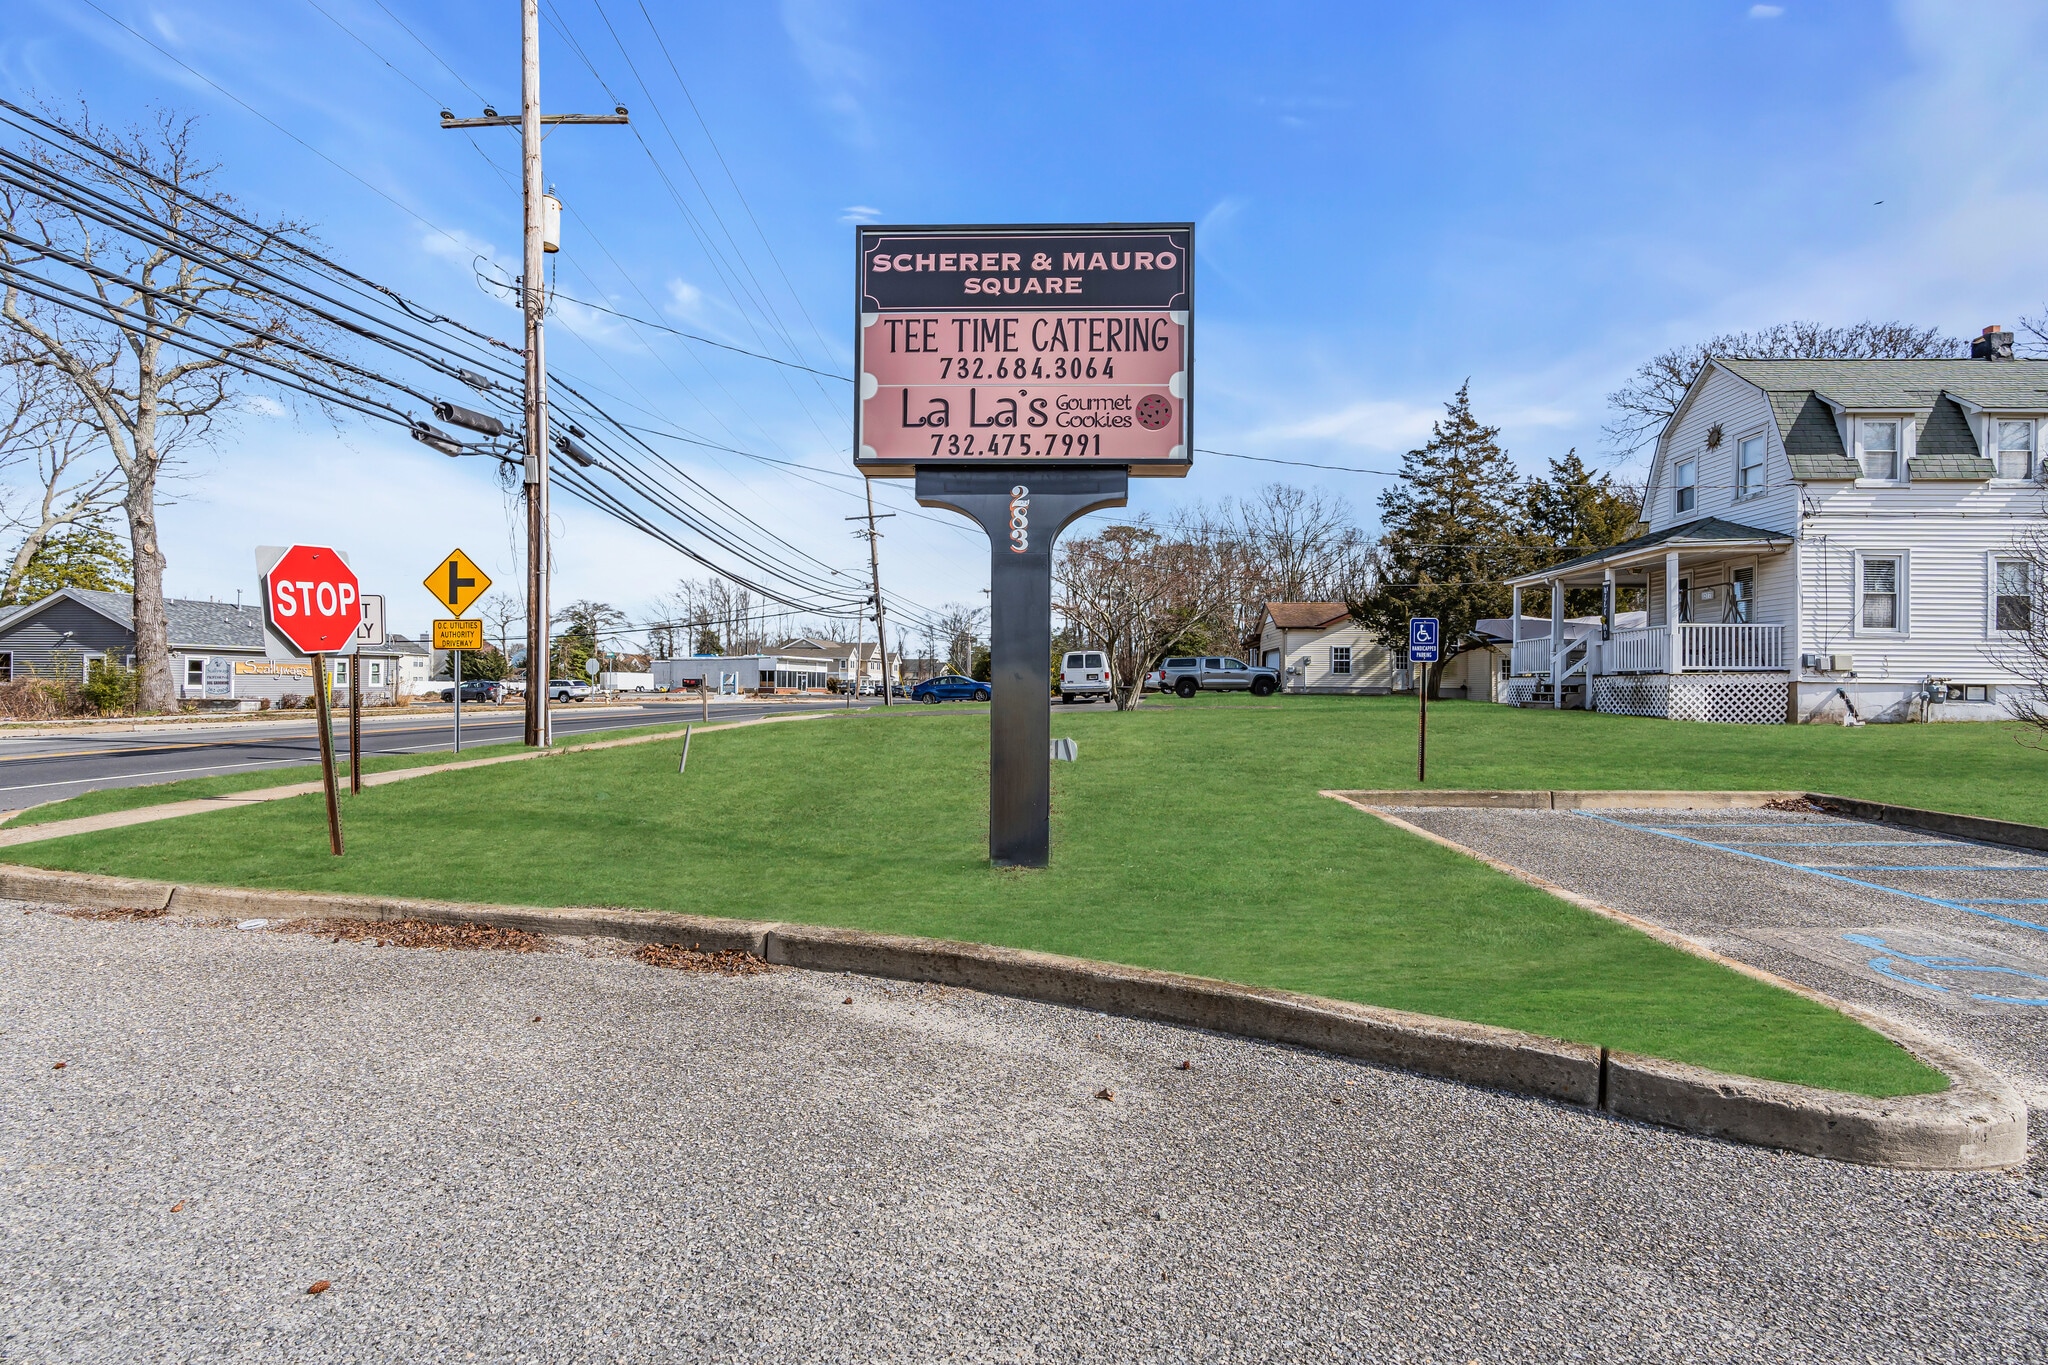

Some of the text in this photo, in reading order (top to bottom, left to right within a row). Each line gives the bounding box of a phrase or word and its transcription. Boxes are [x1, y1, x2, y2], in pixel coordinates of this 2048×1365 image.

[872, 251, 1178, 272] SCHERER & MAURO
[963, 276, 1083, 296] SQUARE
[884, 317, 1169, 354] TEE TIME CATERING
[940, 357, 1114, 380] 732.684.3064
[902, 388, 1049, 428] La La's
[1056, 394, 1132, 411] Gourmet
[1056, 411, 1133, 429] Cookies
[930, 433, 1101, 457] 732.475.7991
[1009, 485, 1030, 554] 283
[276, 580, 356, 617] STOP
[357, 623, 374, 638] LY
[440, 631, 475, 639] AUTHORITY
[449, 621, 478, 630] UTILITIES
[243, 659, 309, 680] Scallywags
